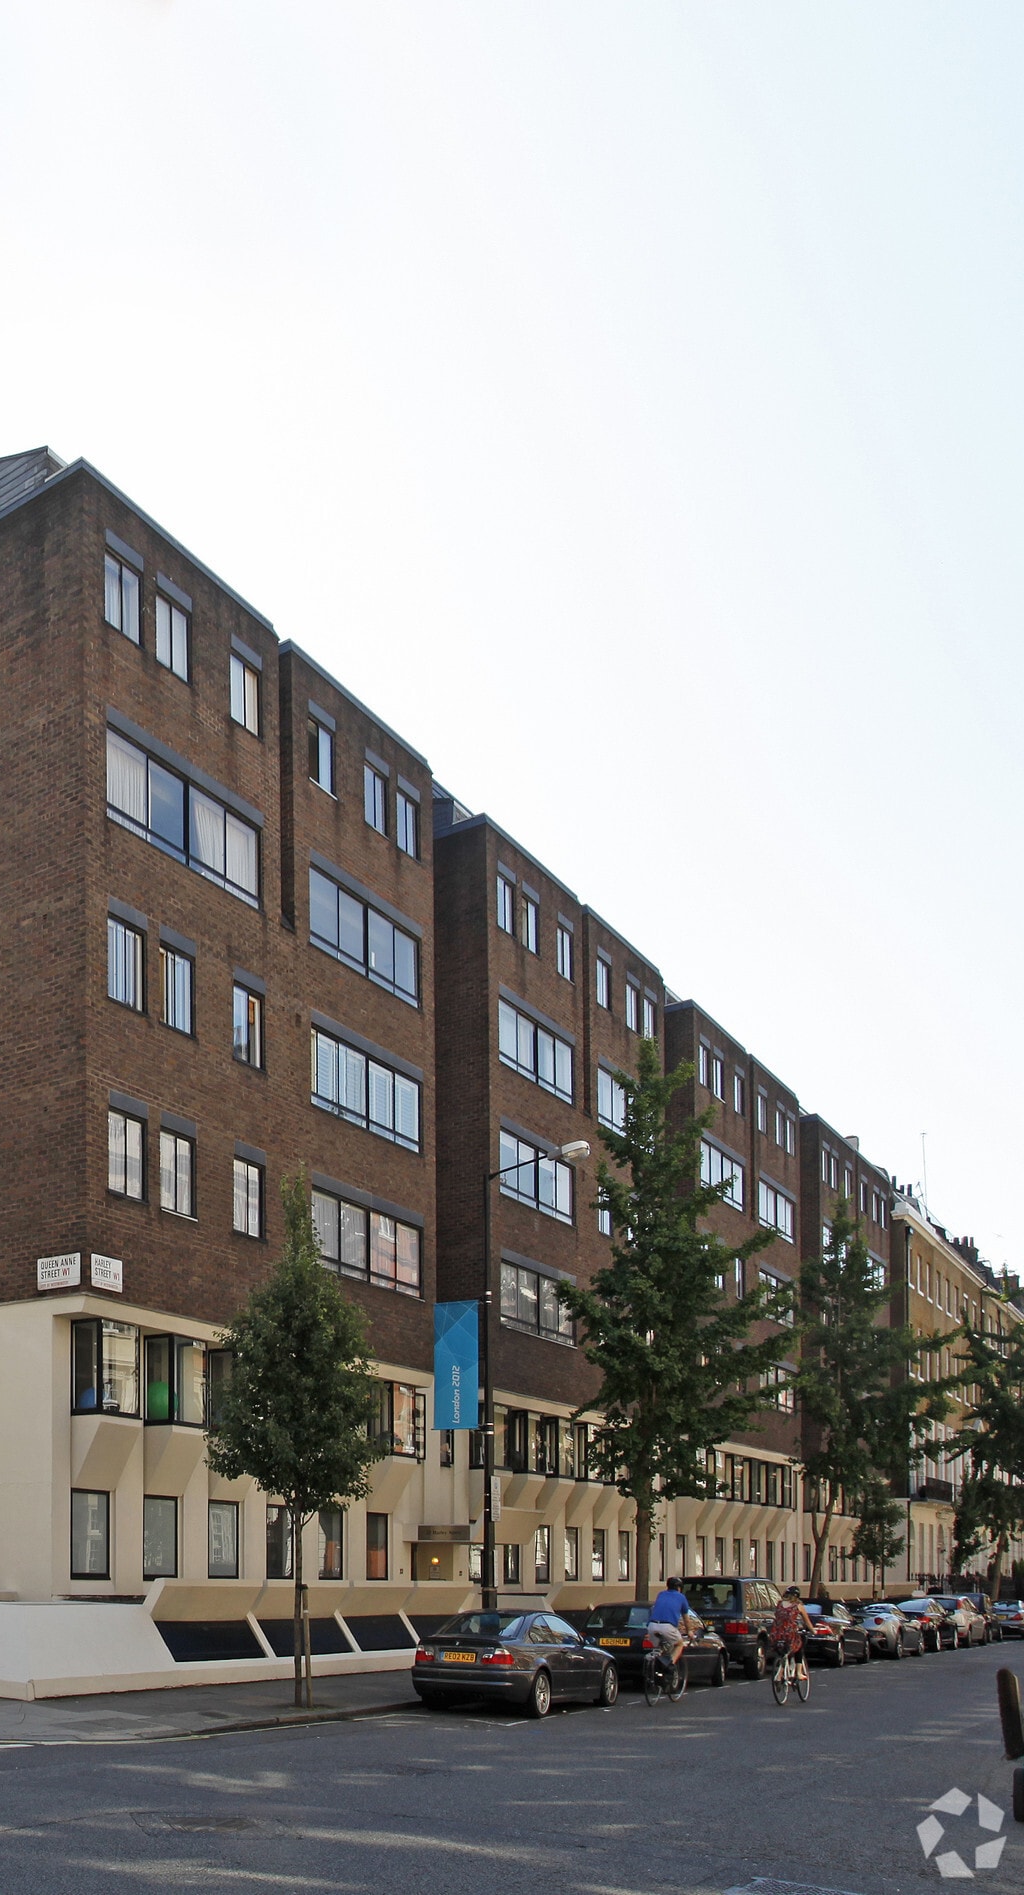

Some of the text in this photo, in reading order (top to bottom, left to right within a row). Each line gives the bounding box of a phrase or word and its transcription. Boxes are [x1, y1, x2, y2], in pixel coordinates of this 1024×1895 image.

[40, 1256, 76, 1270] QUEEN ANNE
[94, 1257, 112, 1269] HARLEY
[40, 1267, 70, 1280] STREET W1
[94, 1267, 112, 1279] STREET
[452, 1365, 461, 1424] London 2012
